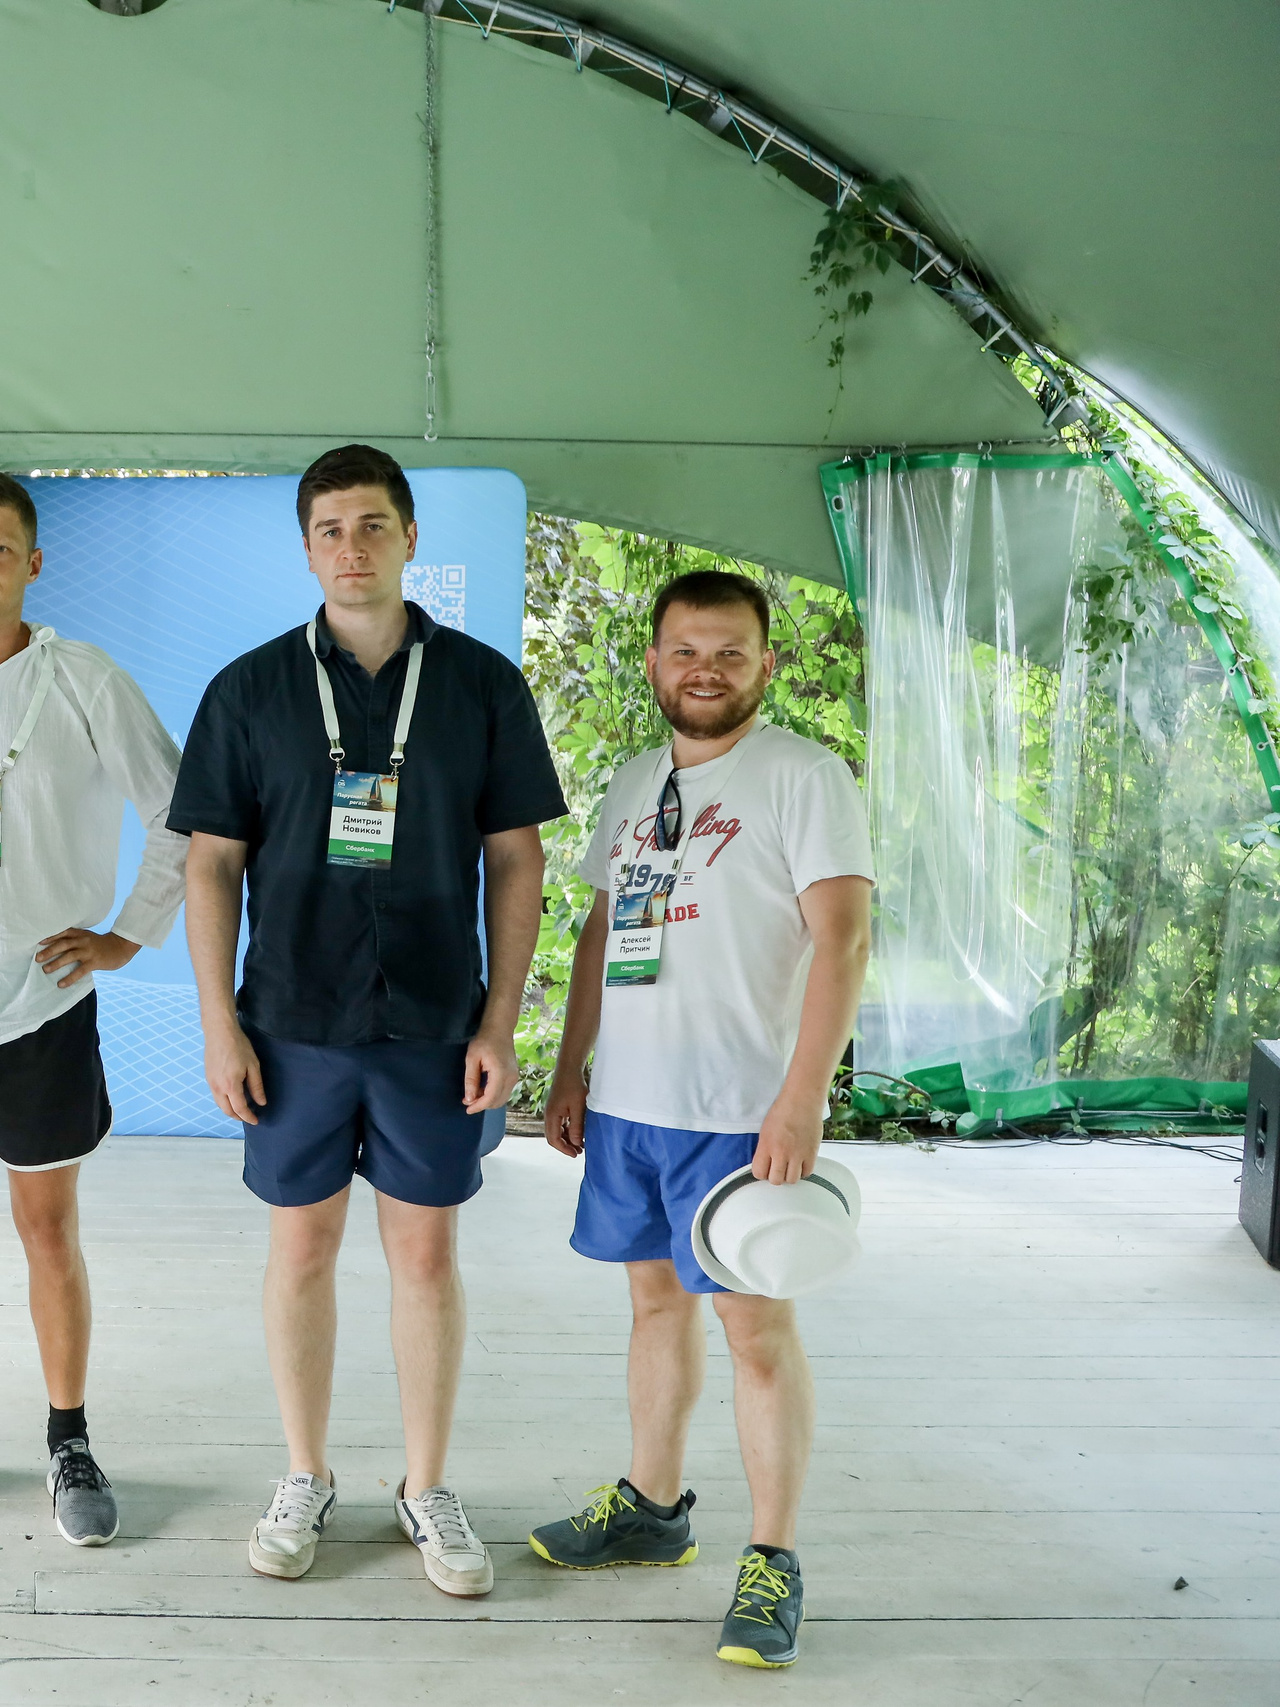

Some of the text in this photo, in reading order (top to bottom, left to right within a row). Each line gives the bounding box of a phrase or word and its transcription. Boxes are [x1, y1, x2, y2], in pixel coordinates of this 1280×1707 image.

[342, 815, 382, 826] Дмитрий
[342, 825, 381, 835] Новиков
[345, 844, 375, 853] Сбербанк
[621, 935, 651, 945] Алексей
[619, 945, 651, 954] Притчин
[295, 1477, 310, 1485] VANS
